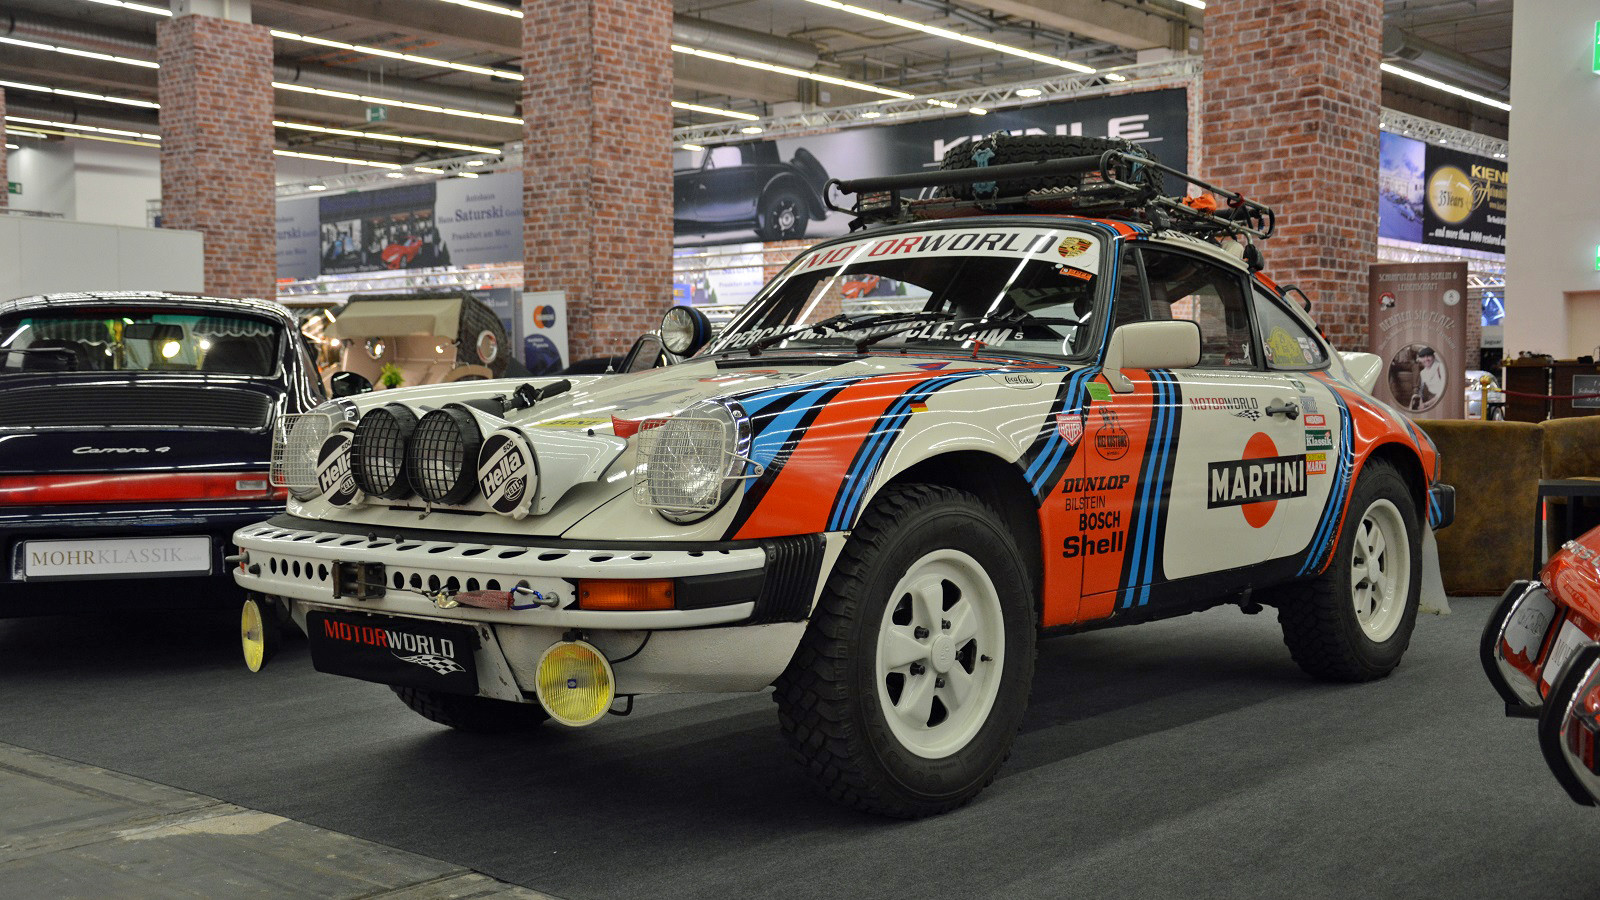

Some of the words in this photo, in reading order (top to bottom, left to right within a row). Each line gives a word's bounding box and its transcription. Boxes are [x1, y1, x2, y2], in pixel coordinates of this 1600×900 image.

[1472, 164, 1508, 184] KIEN
[455, 204, 504, 222] Saturski
[800, 233, 1059, 271] MOORWORLD
[1014, 332, 1025, 341] 5
[1189, 397, 1259, 411] MOTORWORLD
[72, 446, 150, 455] Carrera
[341, 439, 352, 451] 500
[503, 440, 514, 453] 500
[1306, 437, 1332, 447] Klassik
[484, 452, 522, 498] Hella
[1307, 460, 1327, 473] MARKT
[341, 478, 355, 491] HELL
[1062, 475, 1130, 494] DUNLOP
[1211, 460, 1304, 503] MARTINI
[1065, 495, 1106, 512] BILSTEIN
[1079, 511, 1121, 532] BOSCH
[1062, 531, 1124, 559] Shell
[324, 619, 455, 659] MOTORWORLD
